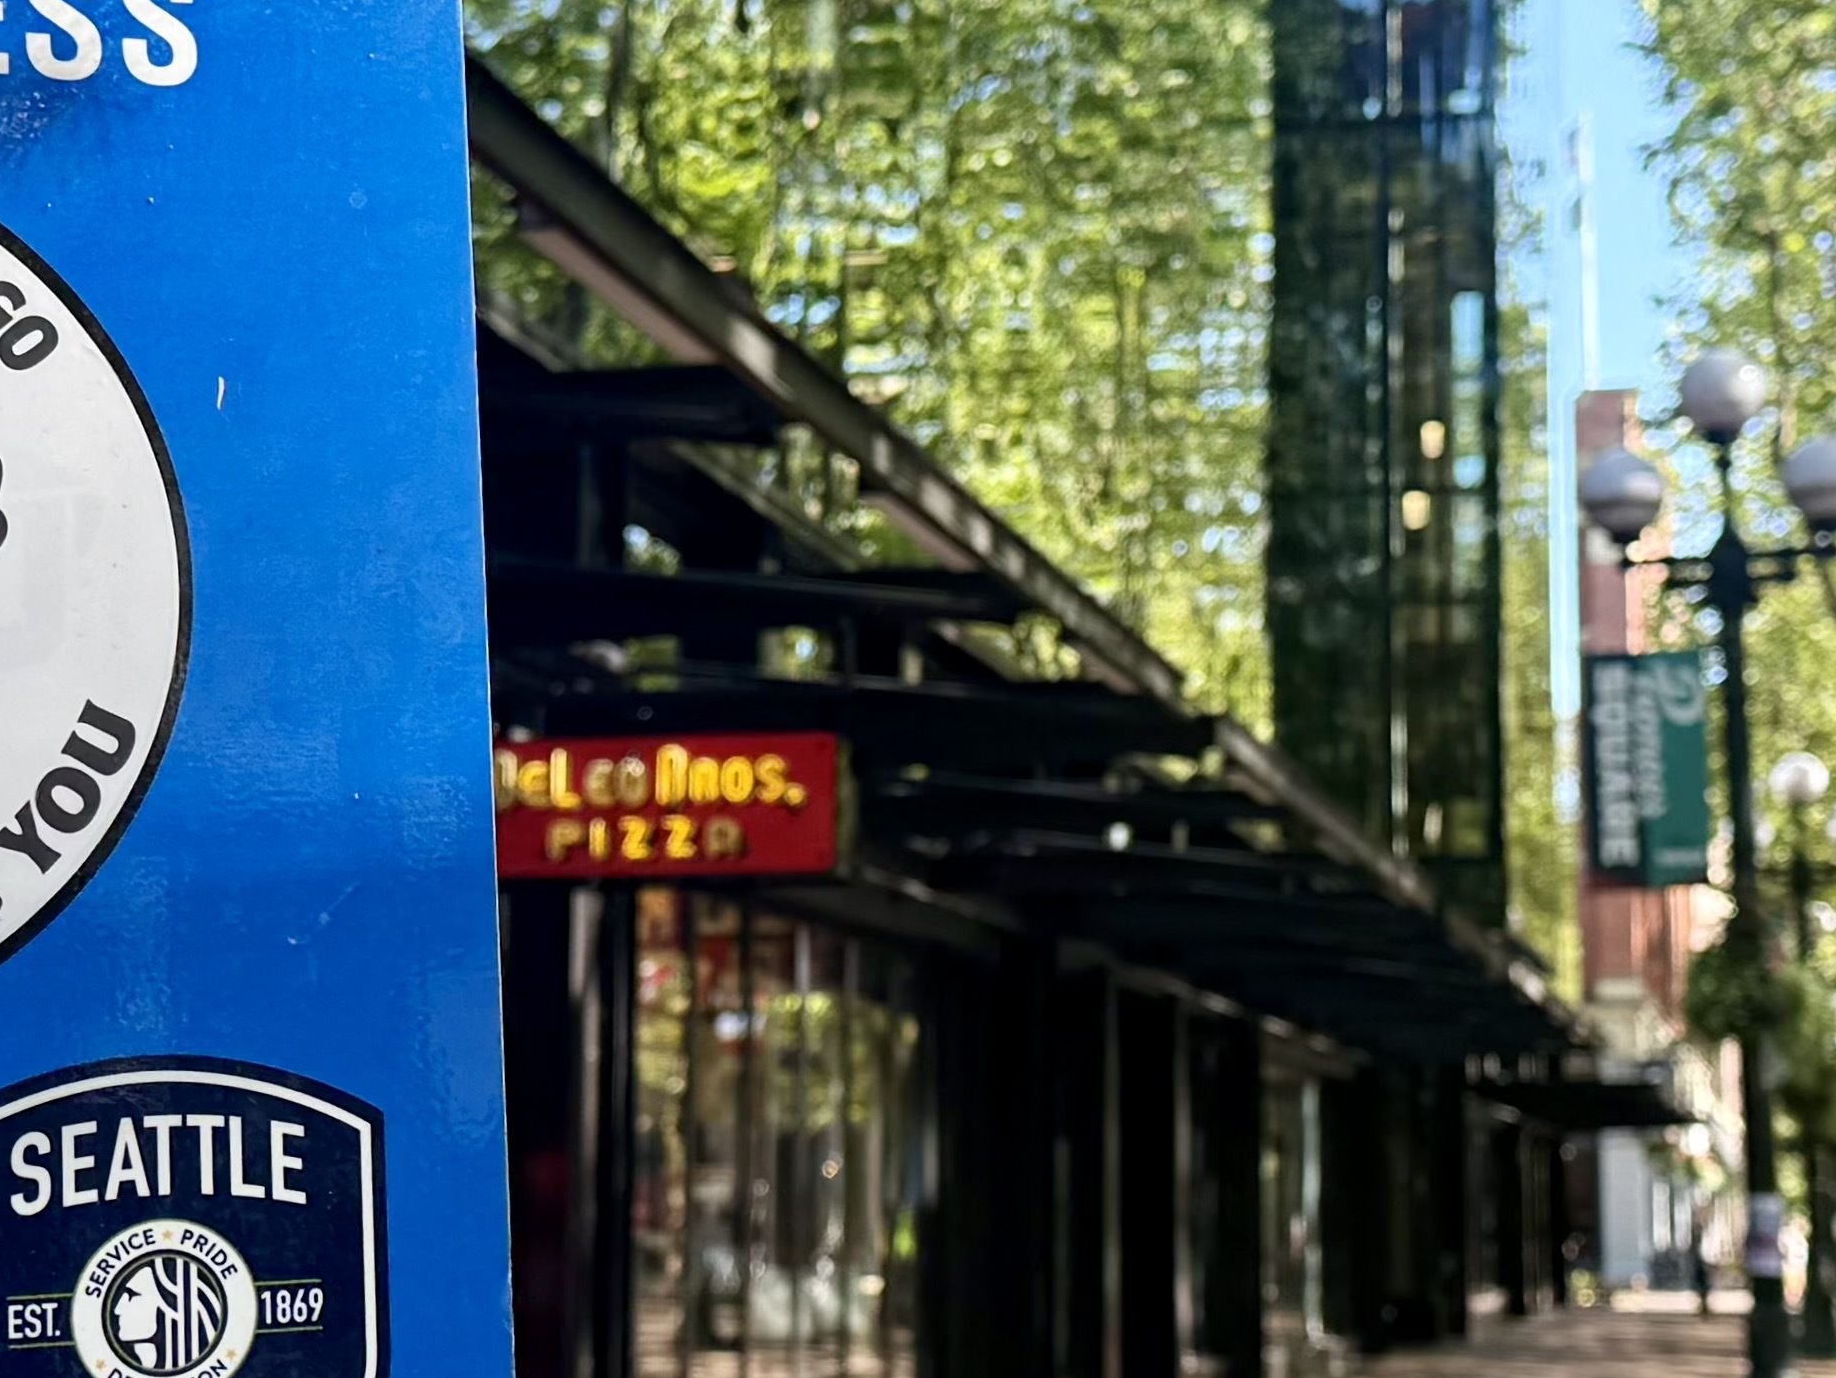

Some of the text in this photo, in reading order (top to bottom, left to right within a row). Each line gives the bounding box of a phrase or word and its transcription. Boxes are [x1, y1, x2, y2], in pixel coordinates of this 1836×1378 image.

[545, 814, 746, 863] PIZZA
[9, 1113, 309, 1217] SEATTLE
[84, 1227, 239, 1300] SERVICE PRIDE
[7, 1287, 325, 1341] EST. 1869
